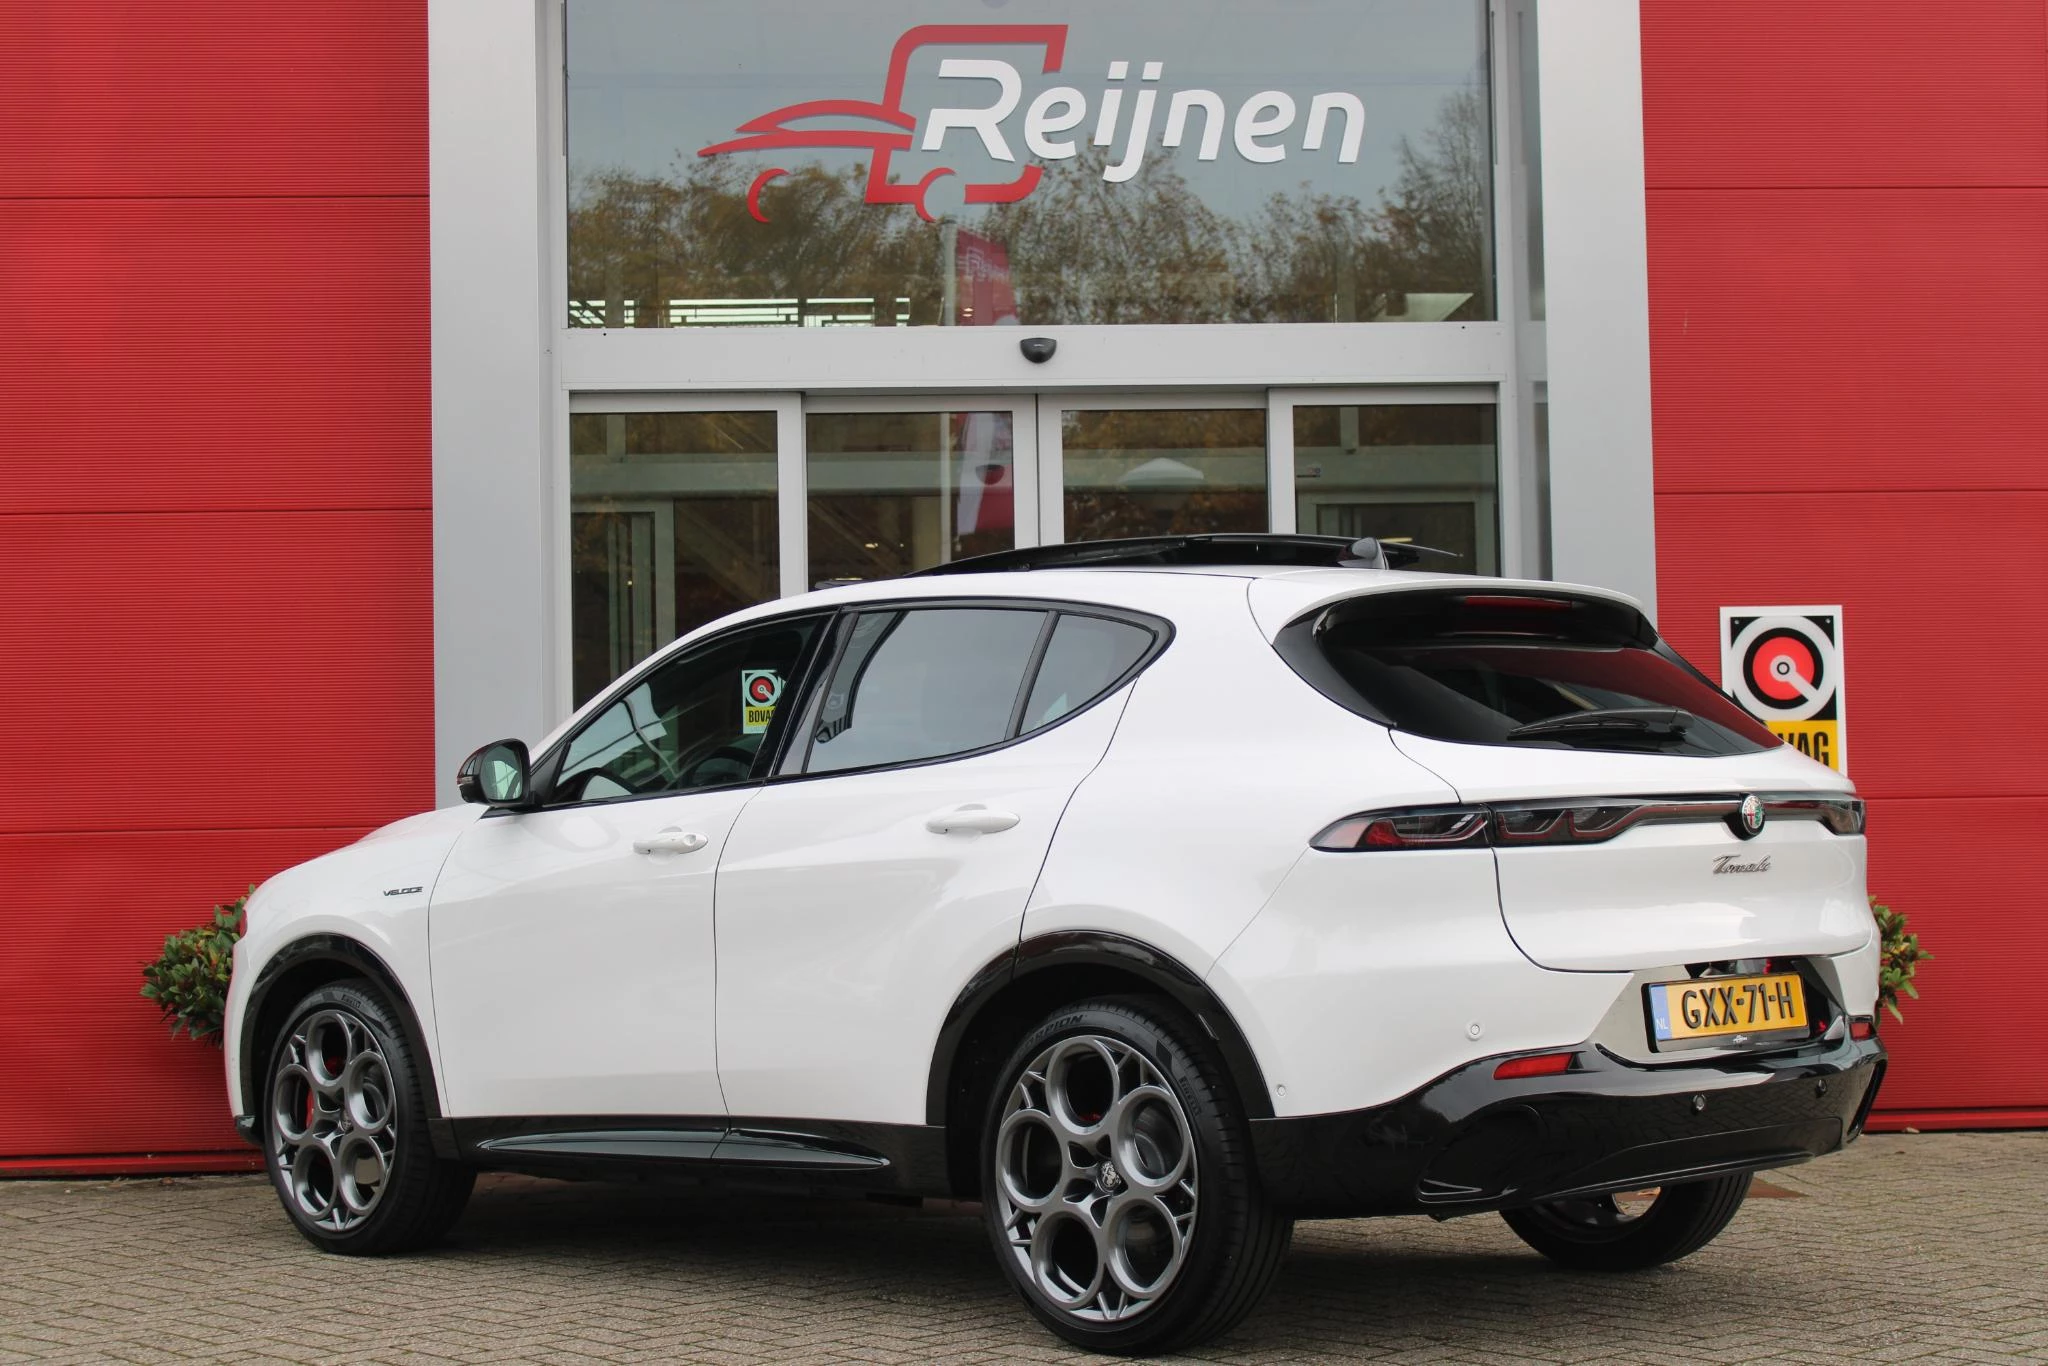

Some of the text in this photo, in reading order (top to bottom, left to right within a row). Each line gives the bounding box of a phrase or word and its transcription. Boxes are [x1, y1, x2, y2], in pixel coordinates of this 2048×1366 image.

[921, 59, 1365, 183] Reijnen
[748, 710, 774, 723] BOVA
[383, 886, 423, 897] VELOCE
[1682, 981, 1795, 1029] GXX-71-H
[1655, 1018, 1669, 1030] NL
